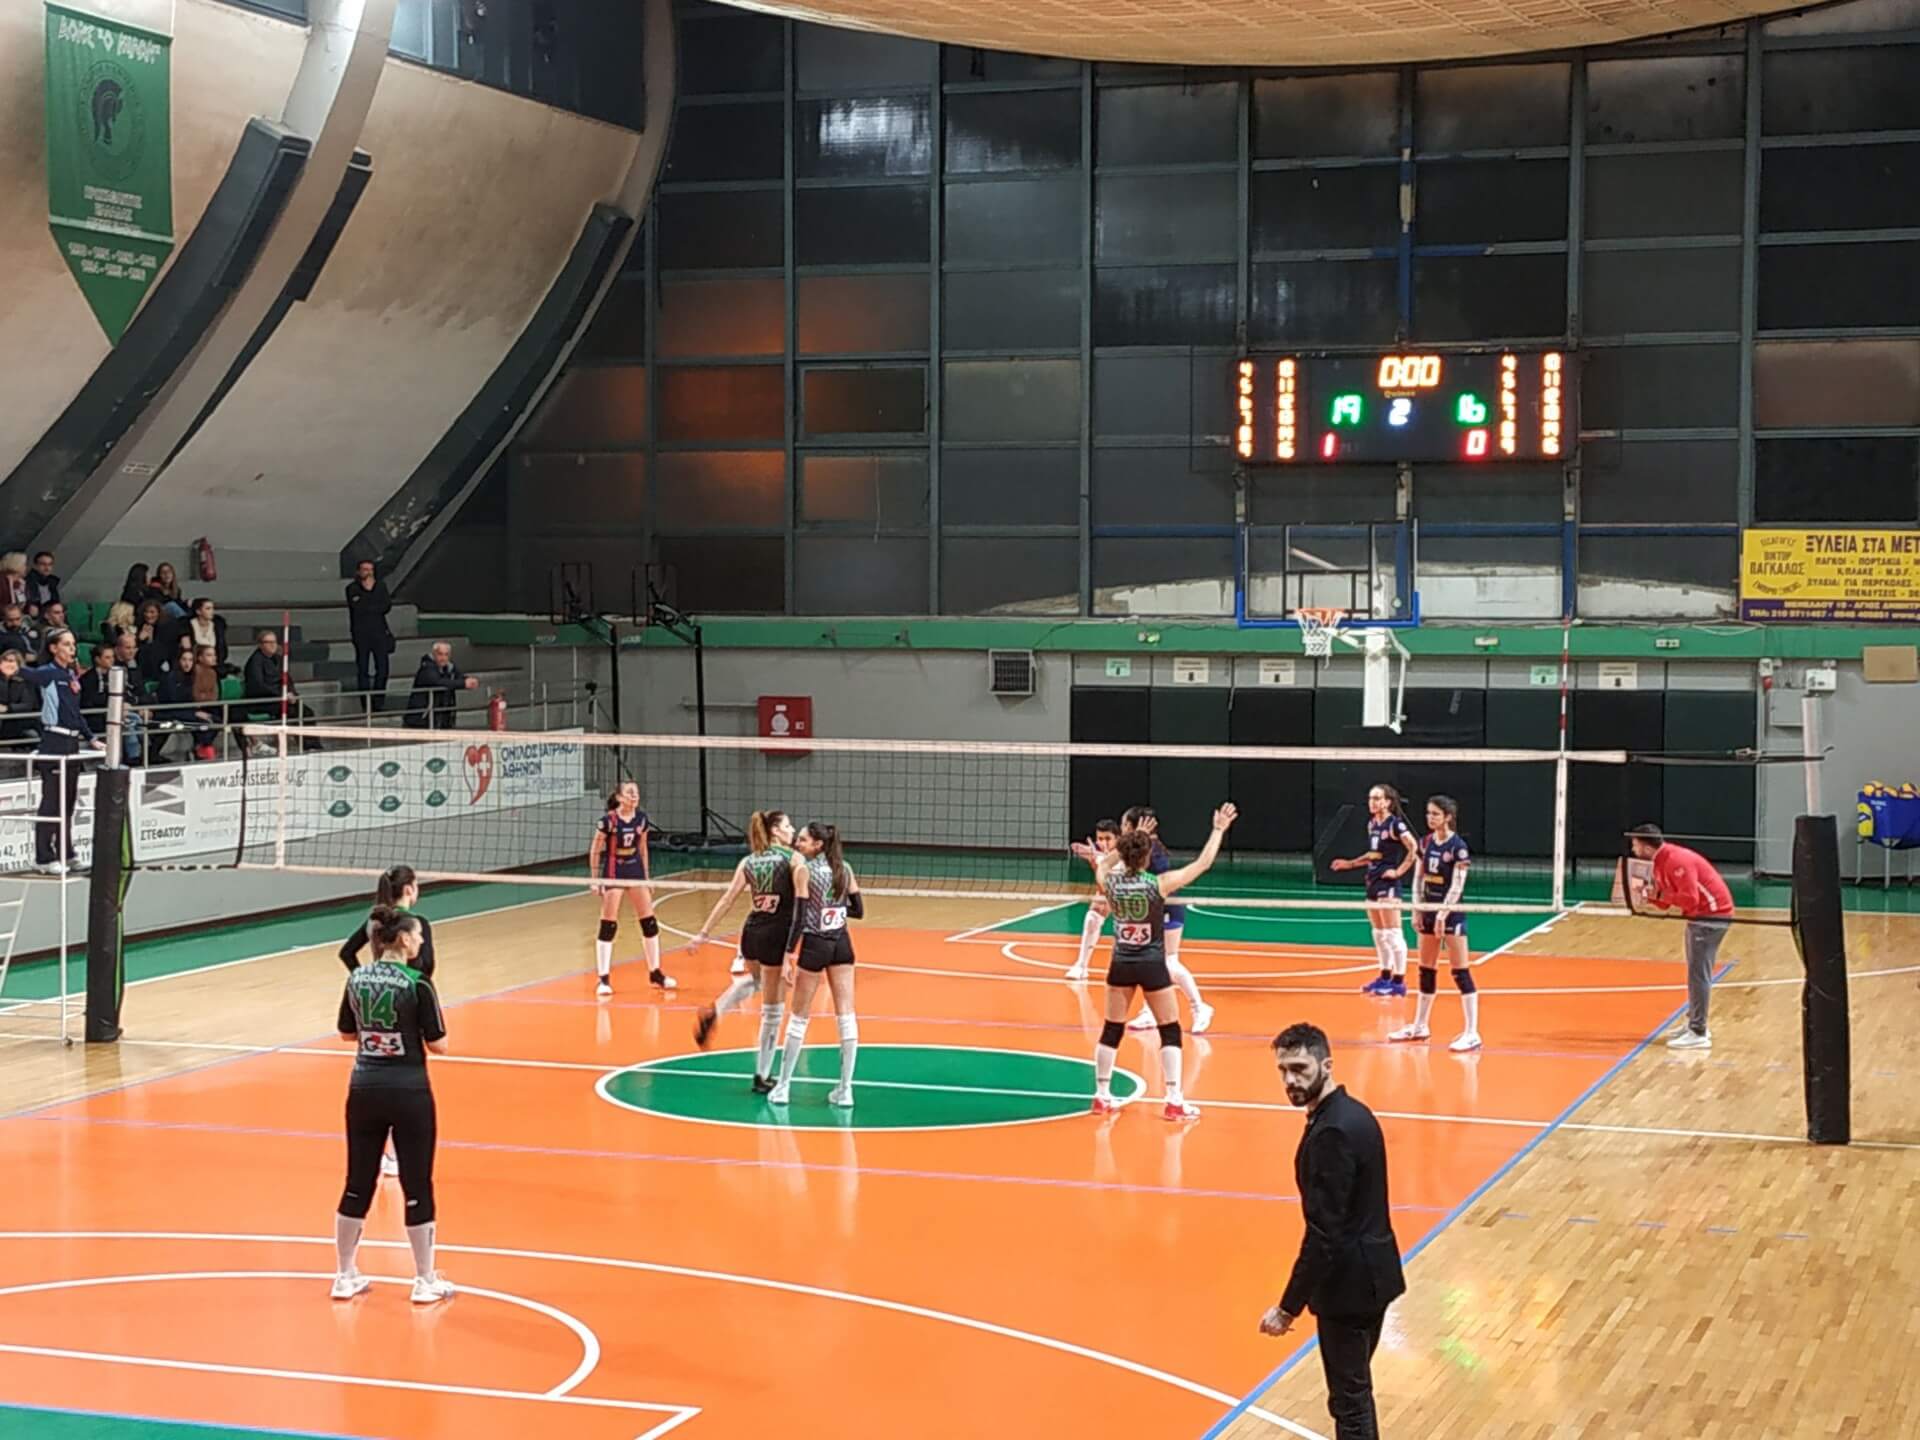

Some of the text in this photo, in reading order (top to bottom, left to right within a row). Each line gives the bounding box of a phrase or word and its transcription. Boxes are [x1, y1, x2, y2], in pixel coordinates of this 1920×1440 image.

[1332, 394, 1362, 424] 19
[1388, 398, 1412, 425] 2
[1457, 393, 1486, 423] 16
[1324, 432, 1335, 457] 1
[1466, 429, 1487, 456] 0
[1806, 535, 1857, 552] ΞΥΛΕΙΑ
[1862, 537, 1886, 553] ΣΤΑ
[140, 826, 186, 841] ΣΤΕΦΑΤΟΥ
[359, 986, 397, 1029] 14
